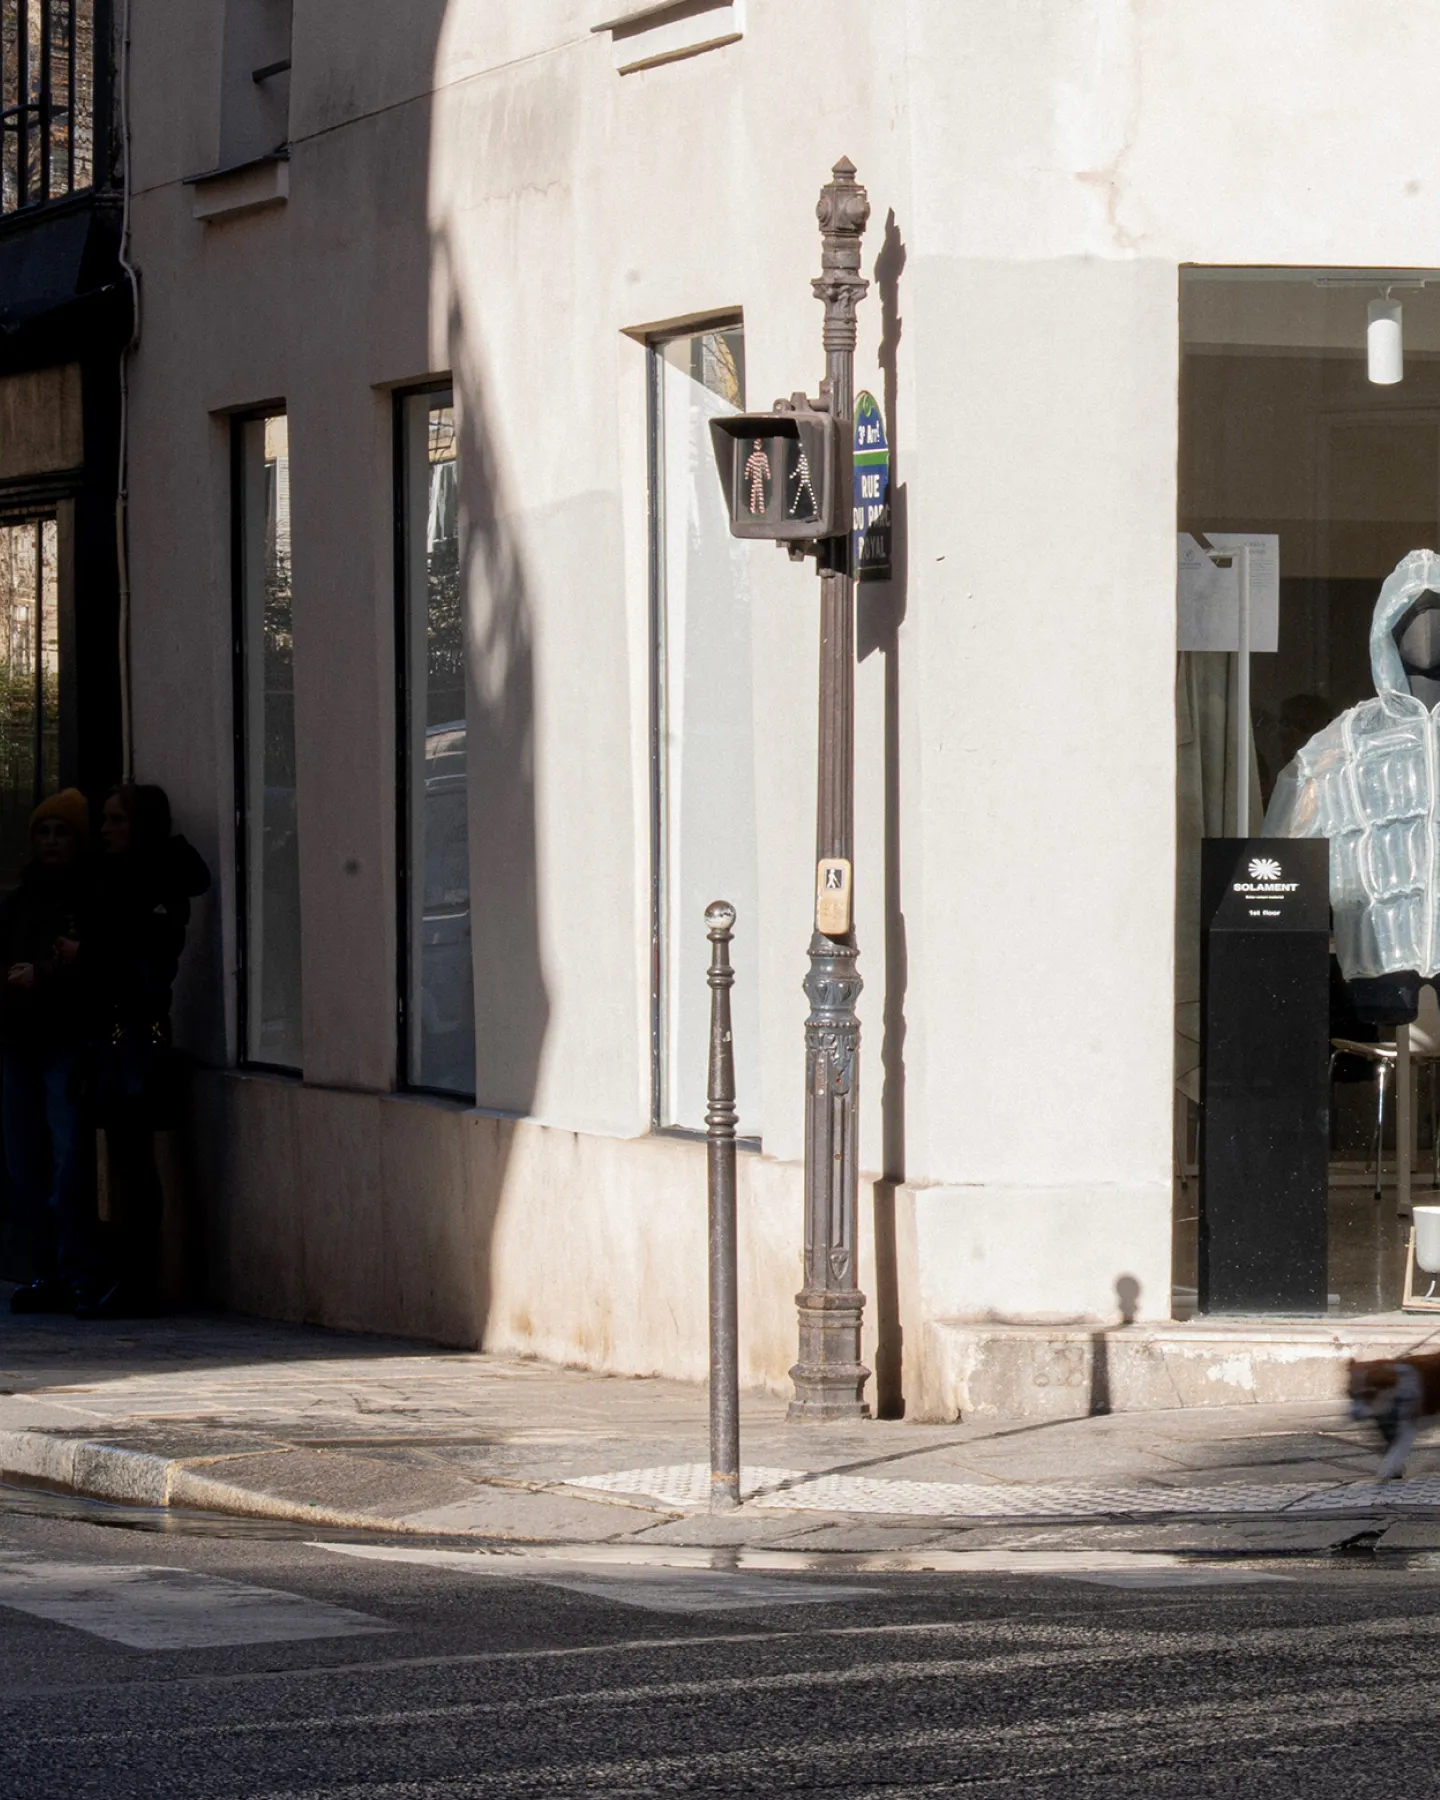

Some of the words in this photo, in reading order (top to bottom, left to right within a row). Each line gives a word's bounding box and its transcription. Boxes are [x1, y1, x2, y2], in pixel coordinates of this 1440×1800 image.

[861, 474, 880, 498] RUE
[853, 507, 865, 531] DU
[868, 504, 892, 528] PARC
[858, 535, 887, 560] ROYAL
[1233, 883, 1299, 892] SOLAMENT
